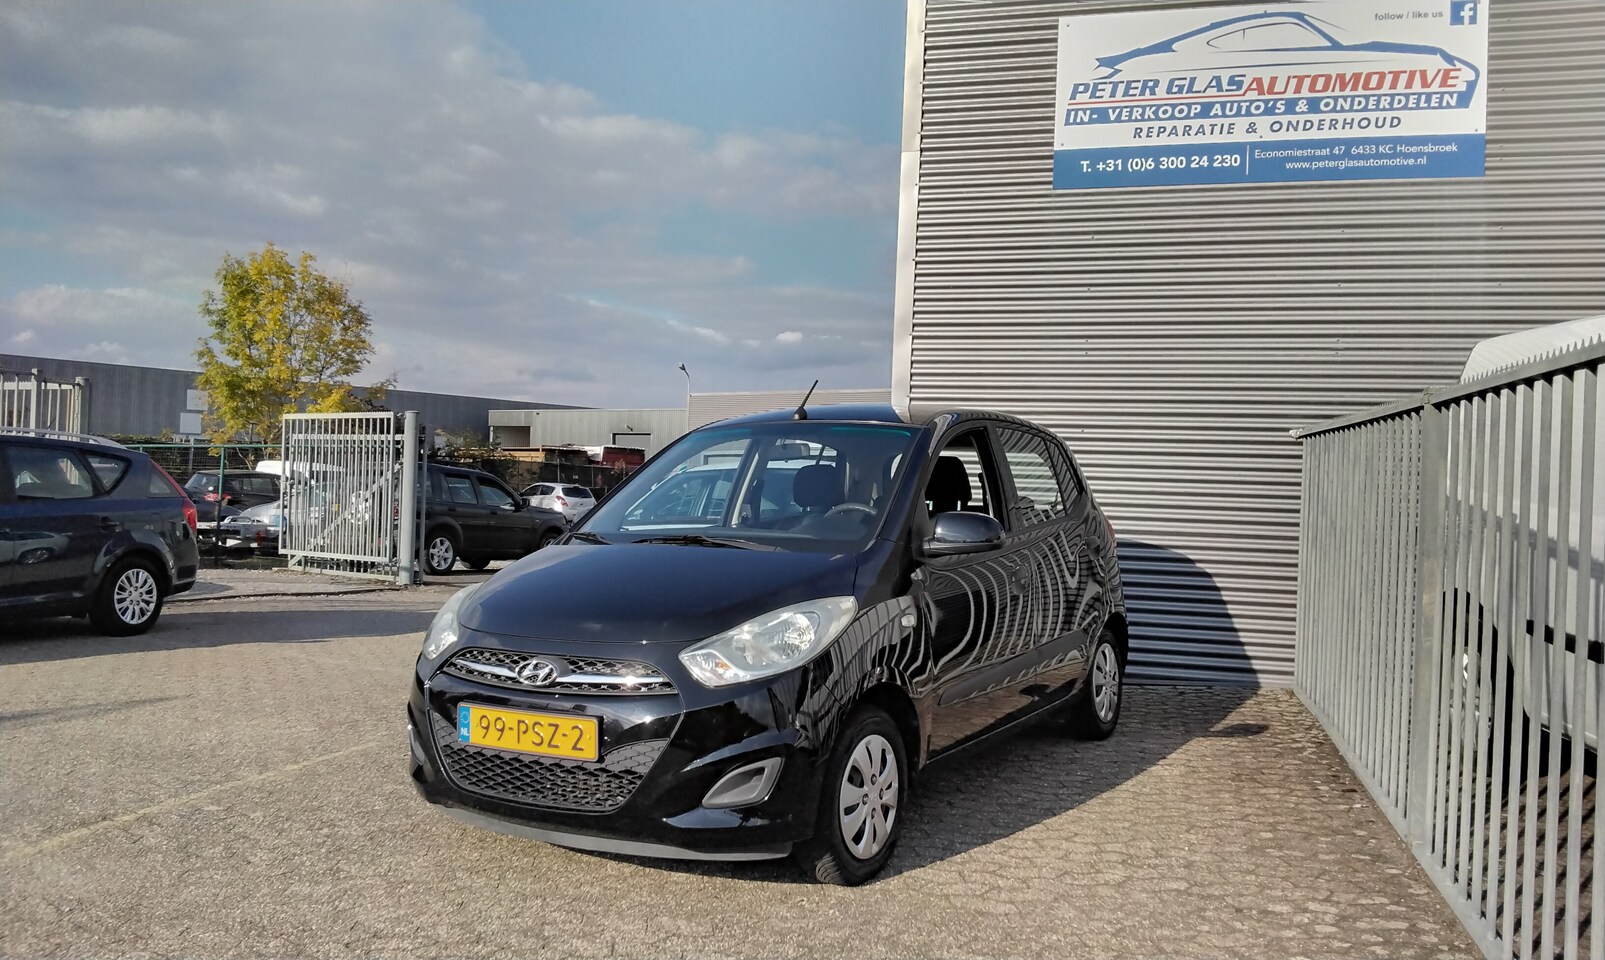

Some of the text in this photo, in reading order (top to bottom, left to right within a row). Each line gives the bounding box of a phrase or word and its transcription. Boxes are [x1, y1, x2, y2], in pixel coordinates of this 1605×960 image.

[1374, 13, 1404, 21] follow
[1412, 11, 1429, 19] like
[1069, 77, 1160, 101] PETER
[1069, 93, 1458, 123] IN- VERKOOP AUTO'S & ONDERDELEN
[1133, 116, 1402, 139] REPARATIE & ONDERHOUD
[1254, 142, 1458, 159] Economiestraat 47 6433 KC Hoensbroek
[1080, 154, 1241, 173] T. +31 (0)6 300 24 230
[1285, 155, 1427, 170] www.peterglasautomotive.nl
[460, 727, 470, 737] NL
[479, 714, 584, 752] 99-PSZ-2
